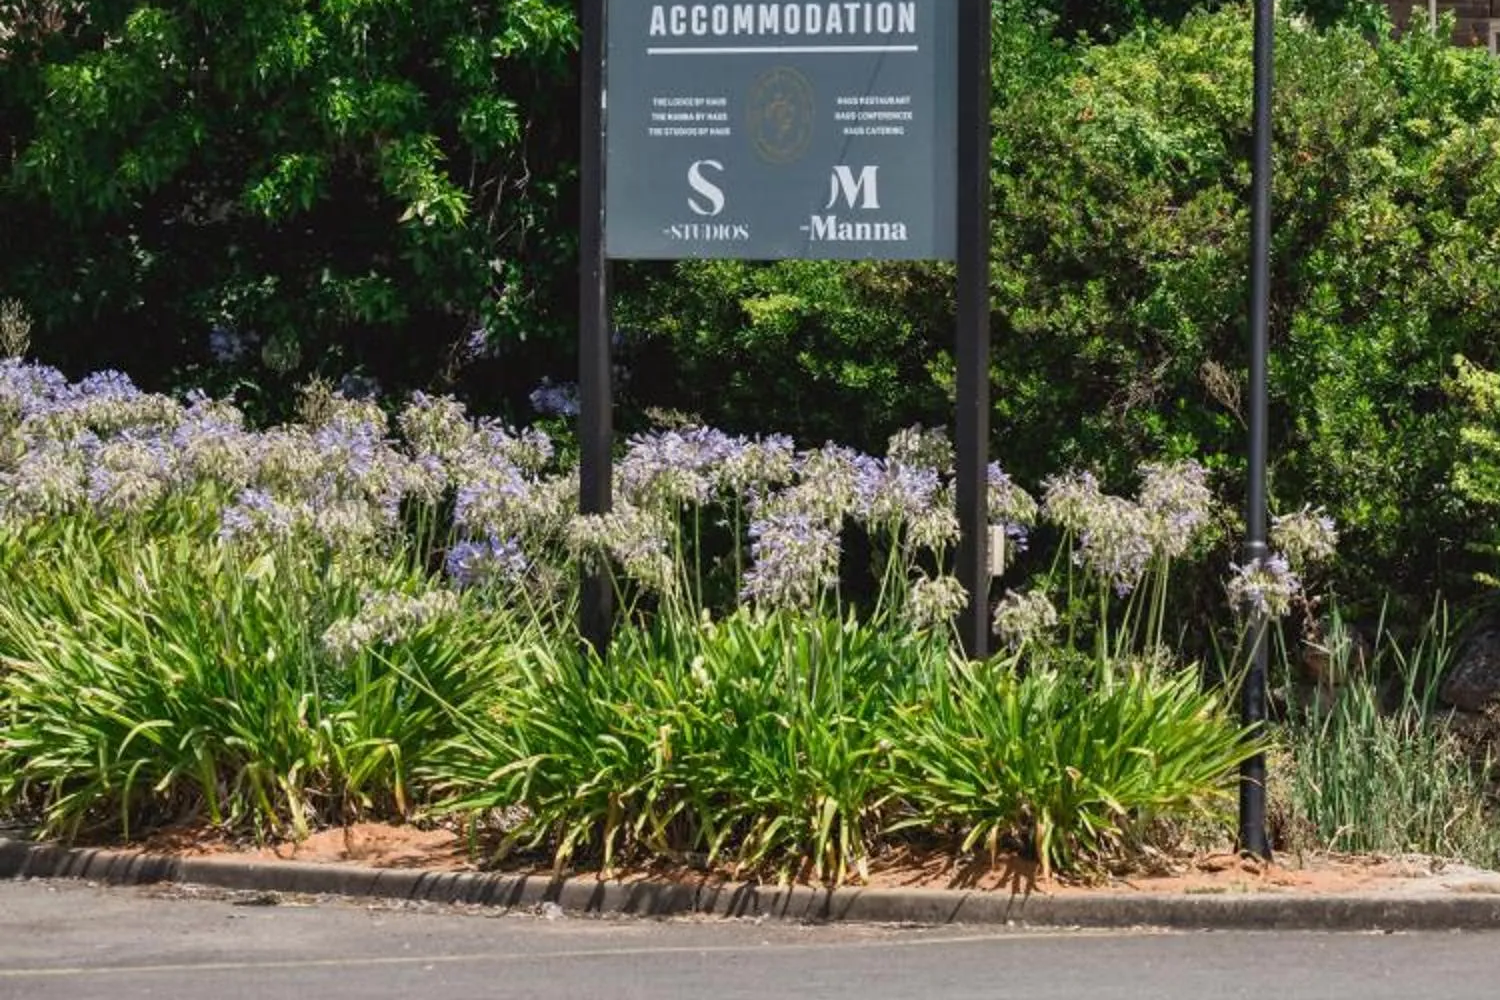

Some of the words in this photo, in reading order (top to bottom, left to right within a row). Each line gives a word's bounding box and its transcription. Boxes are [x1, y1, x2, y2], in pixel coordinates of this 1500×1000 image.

[650, 2, 916, 36] ACCOMMODATION
[671, 223, 750, 241] STUDIOS
[810, 215, 907, 241] Manna
